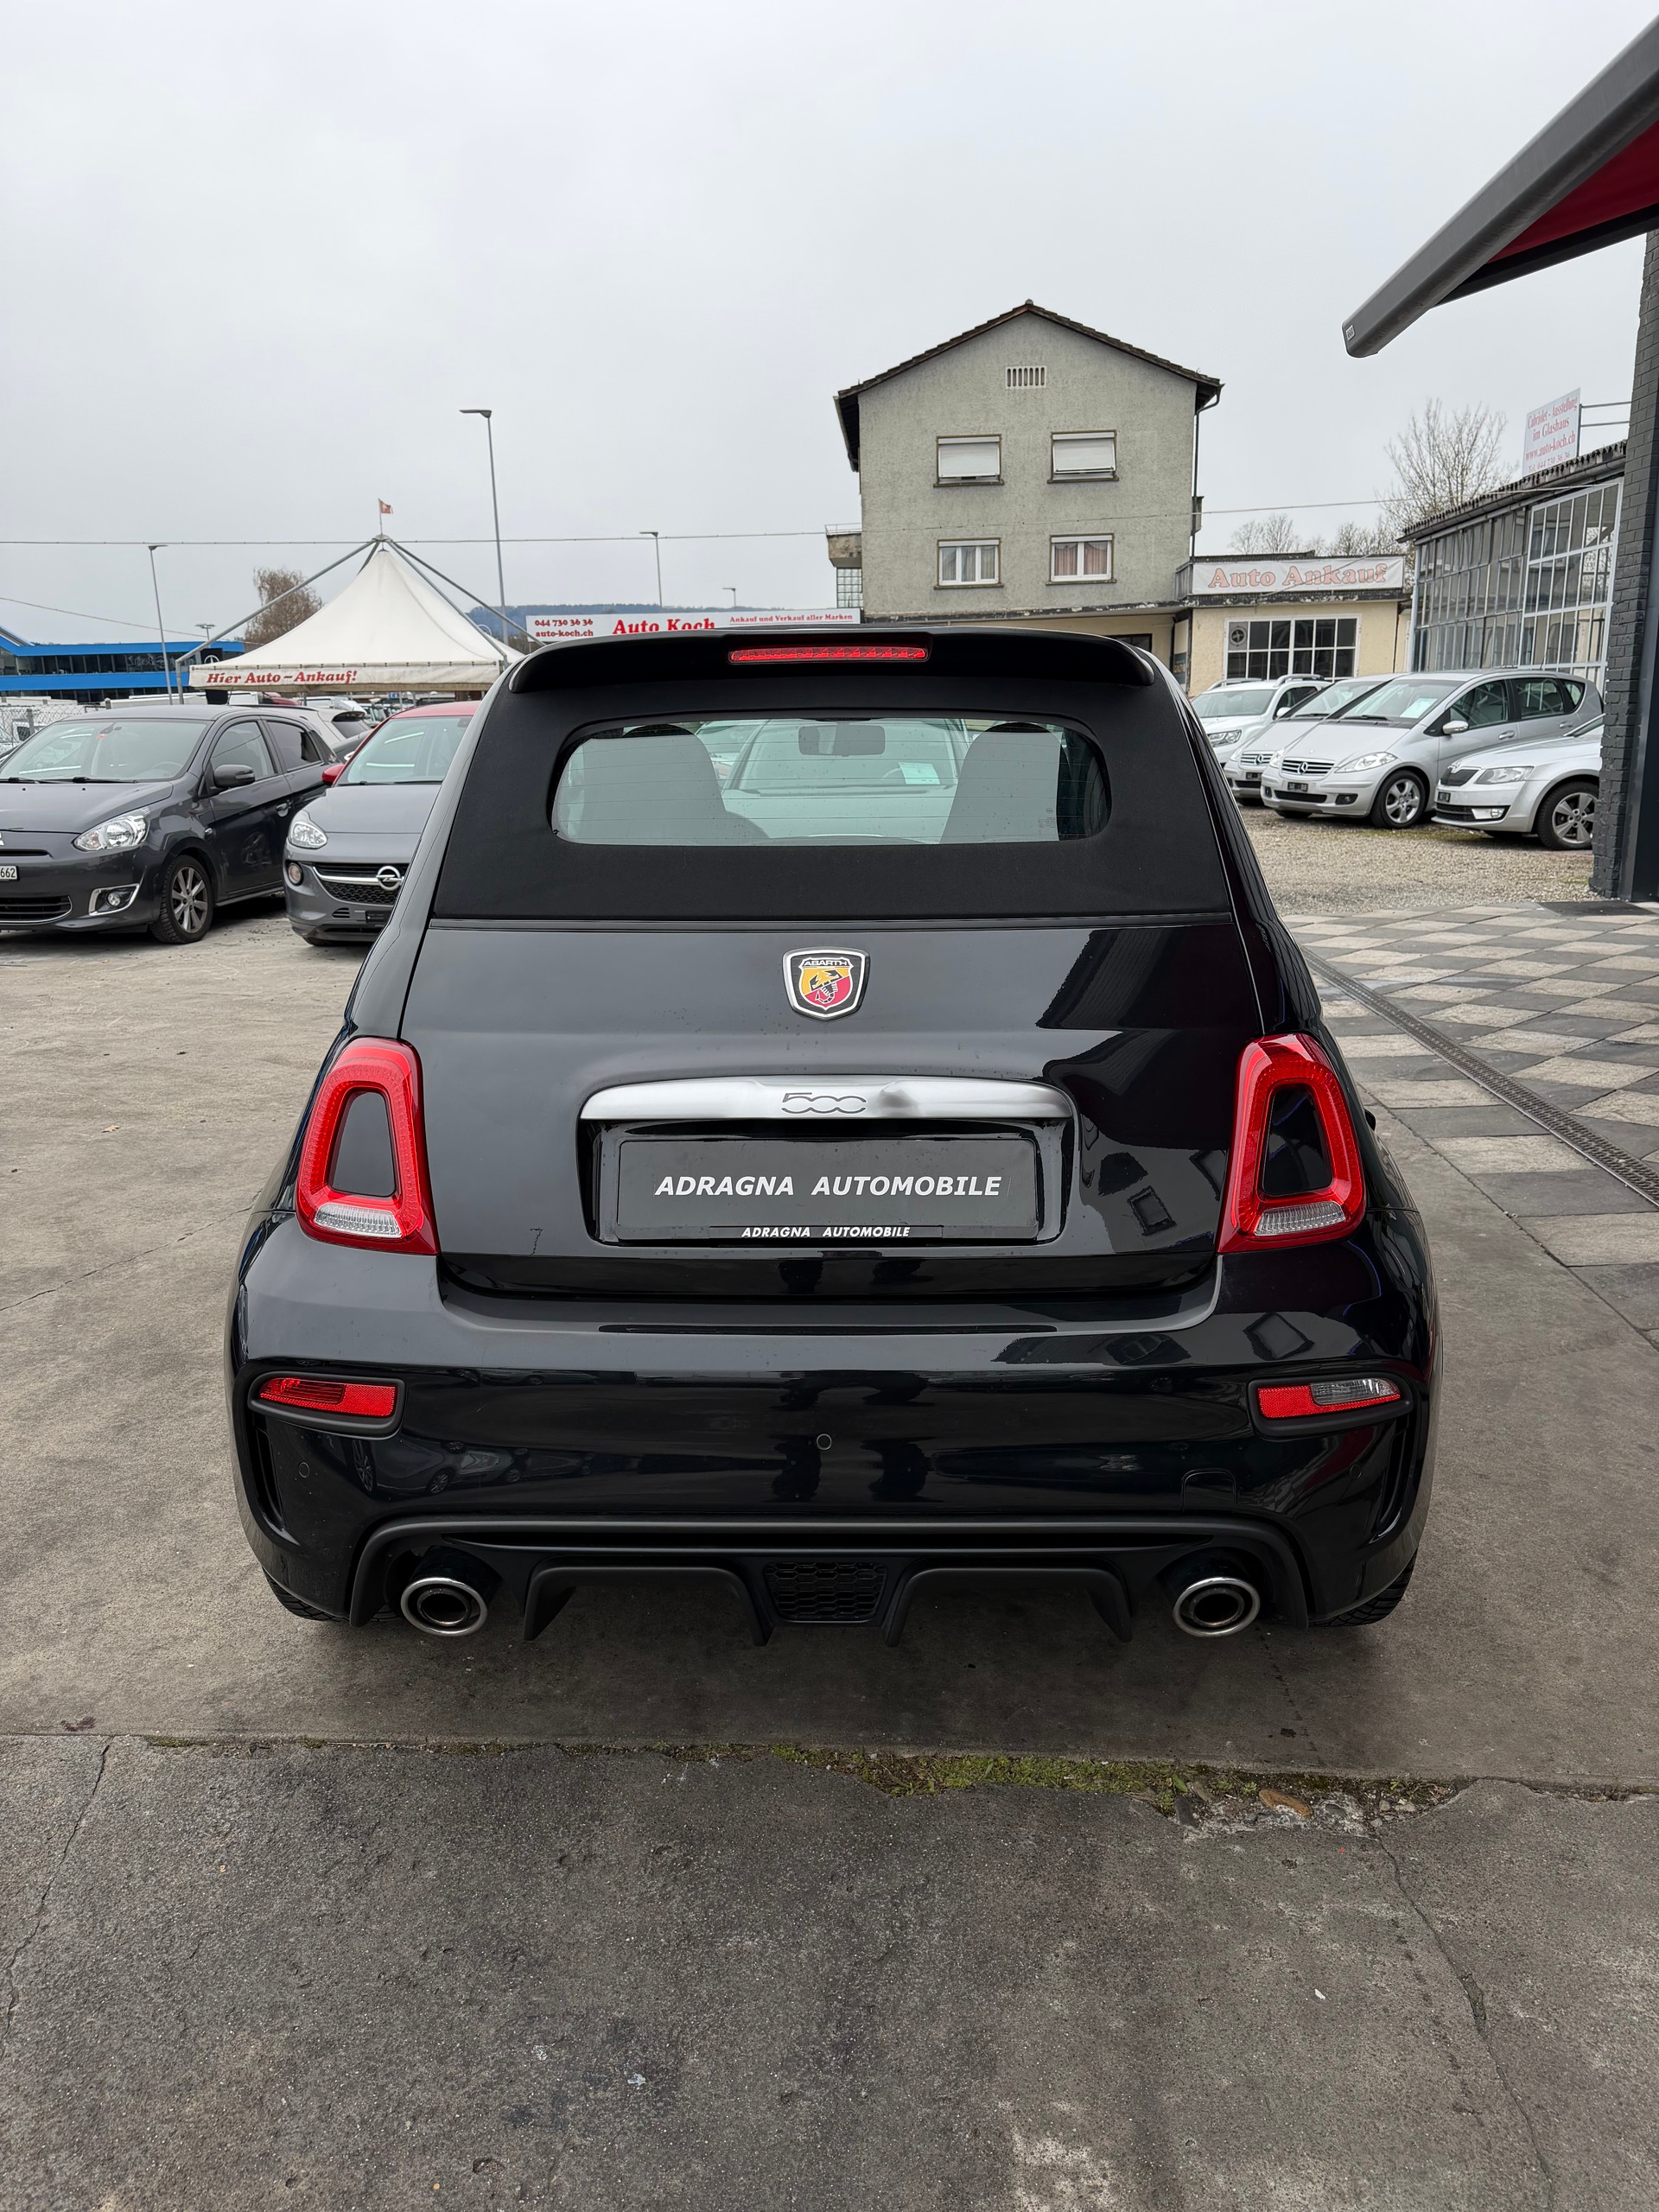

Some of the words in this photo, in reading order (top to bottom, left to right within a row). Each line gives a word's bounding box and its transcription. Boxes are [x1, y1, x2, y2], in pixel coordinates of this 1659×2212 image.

[1208, 567, 1276, 588] Auto
[1282, 563, 1389, 587] Ankauf
[569, 618, 581, 626] 36
[582, 618, 594, 626] 36
[612, 620, 659, 635] Auto
[667, 617, 715, 631] Koch
[536, 629, 594, 638] auto-koch.ch
[207, 672, 241, 683] Hier
[244, 671, 281, 683] Auto
[294, 670, 358, 684] Ankauf!
[781, 1092, 867, 1114] 500
[654, 1176, 794, 1196] ADRAGNA
[810, 1176, 1002, 1196] AUTOMOBILE
[741, 1226, 810, 1237] ADRAGNA
[823, 1226, 911, 1237] AUTOMOBILE
